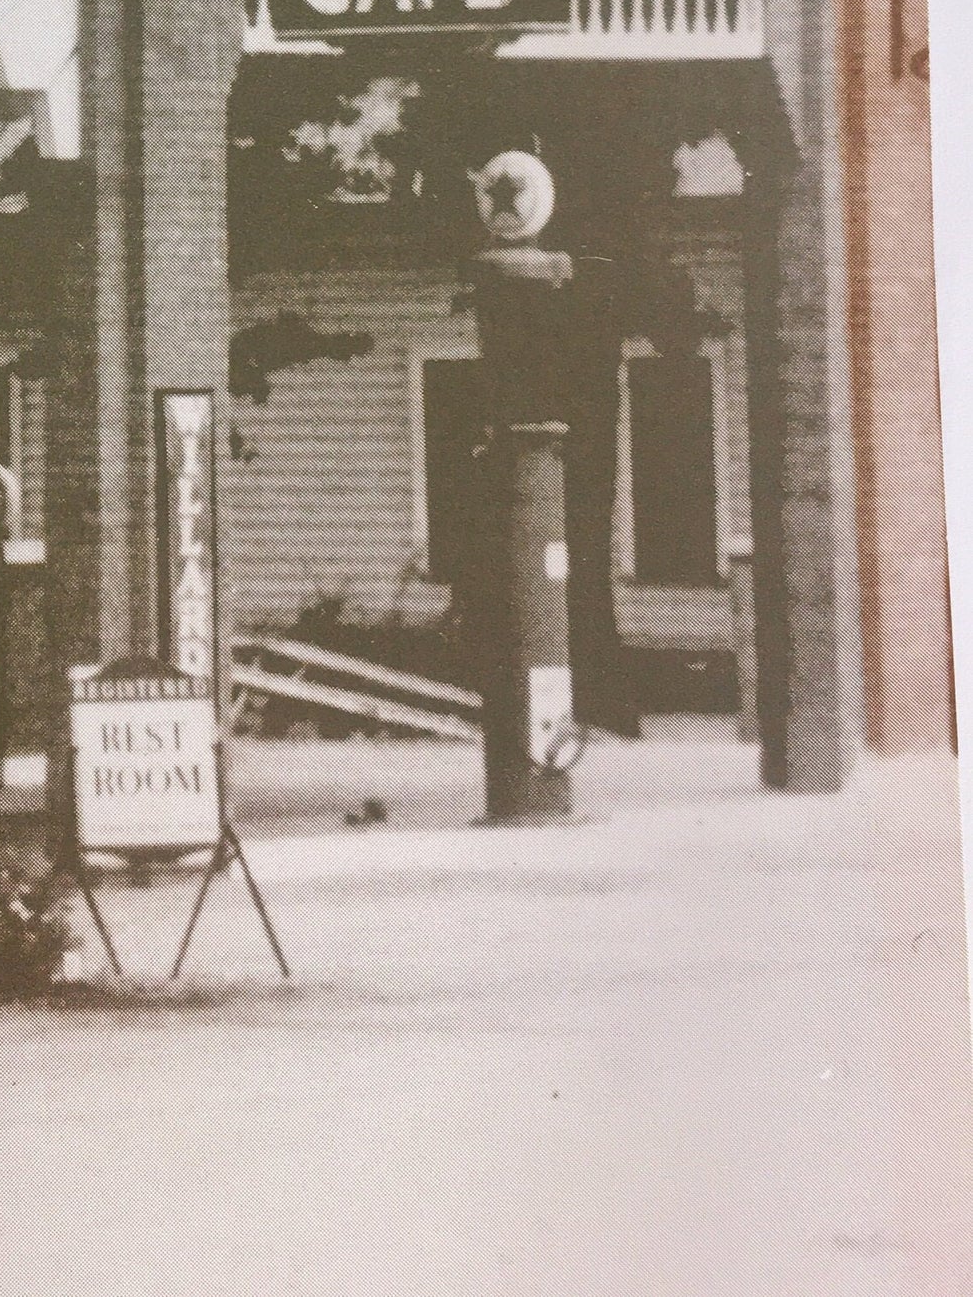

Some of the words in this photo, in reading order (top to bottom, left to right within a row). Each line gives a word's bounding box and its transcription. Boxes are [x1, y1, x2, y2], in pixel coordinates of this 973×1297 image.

[163, 394, 213, 678] WILLARD
[100, 720, 187, 753] REST
[93, 763, 202, 797] ROOM
